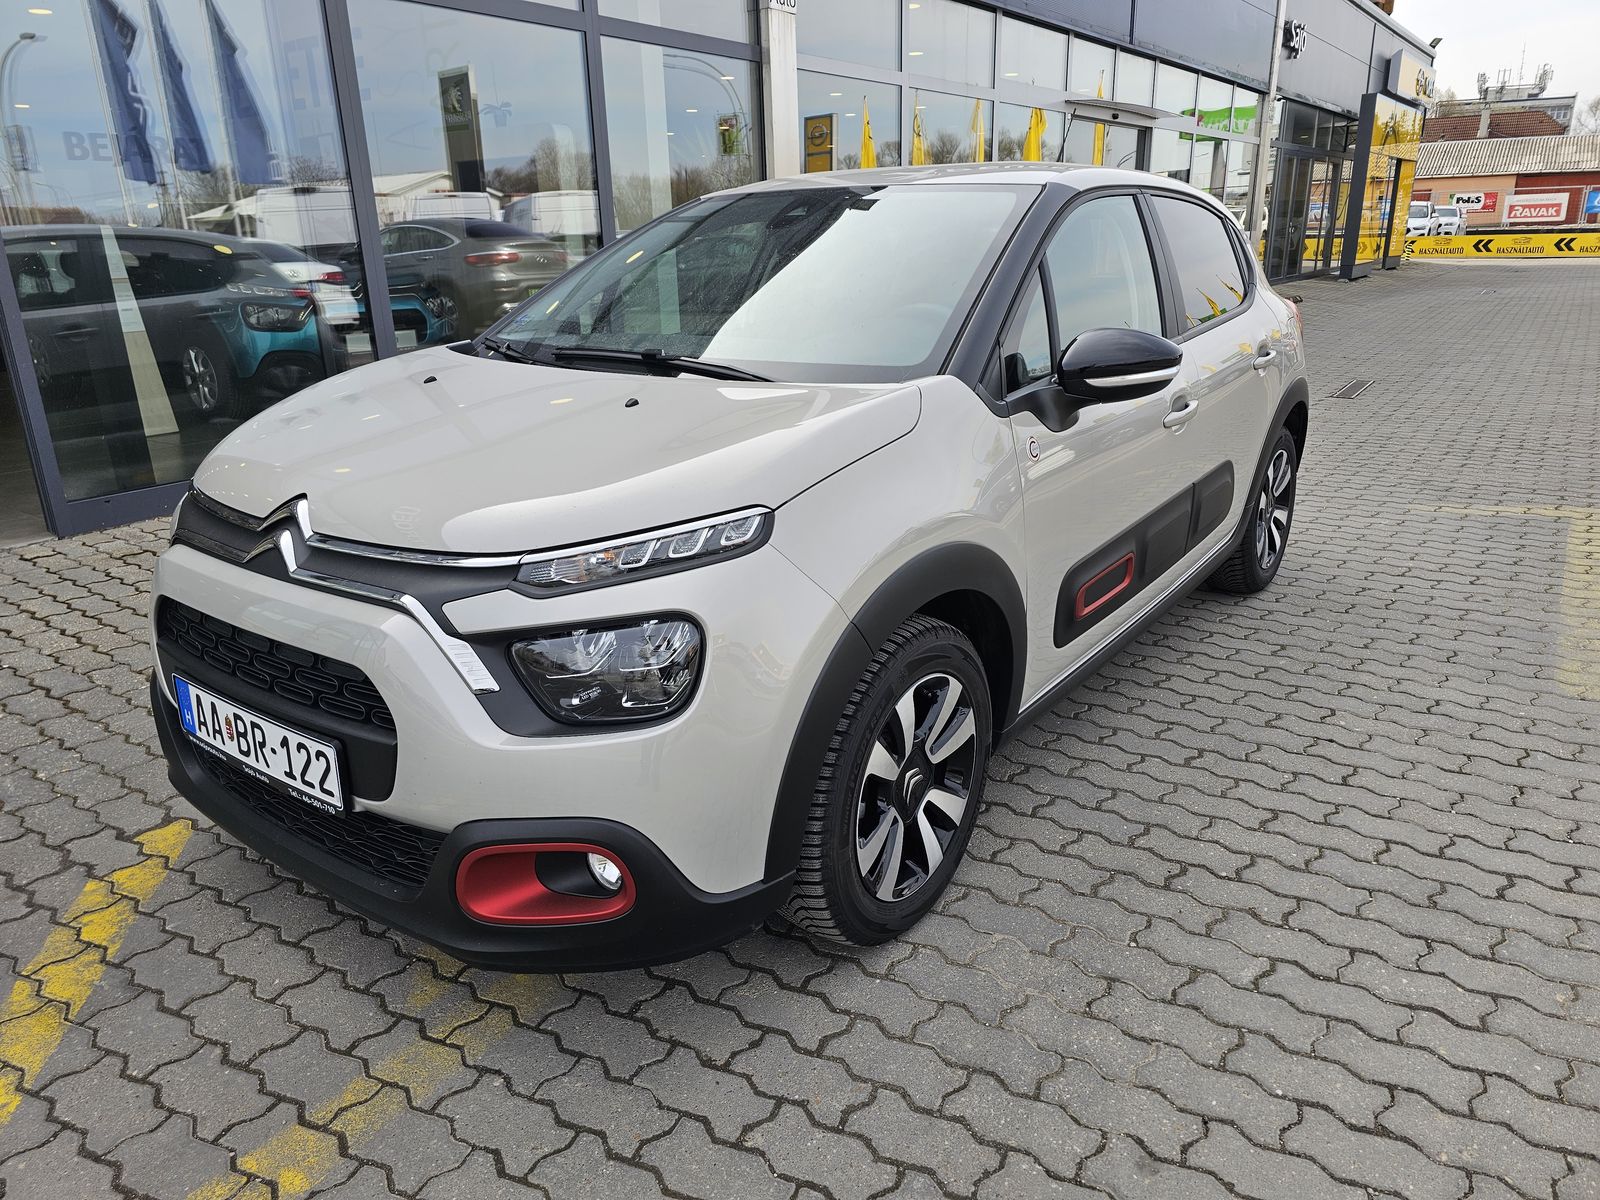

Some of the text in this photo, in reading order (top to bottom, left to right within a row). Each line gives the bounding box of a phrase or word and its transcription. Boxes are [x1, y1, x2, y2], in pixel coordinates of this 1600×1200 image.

[1510, 206, 1560, 217] RAVAK
[1496, 245, 1544, 254] HASZNÁLTAUTÓ
[185, 709, 192, 725] H
